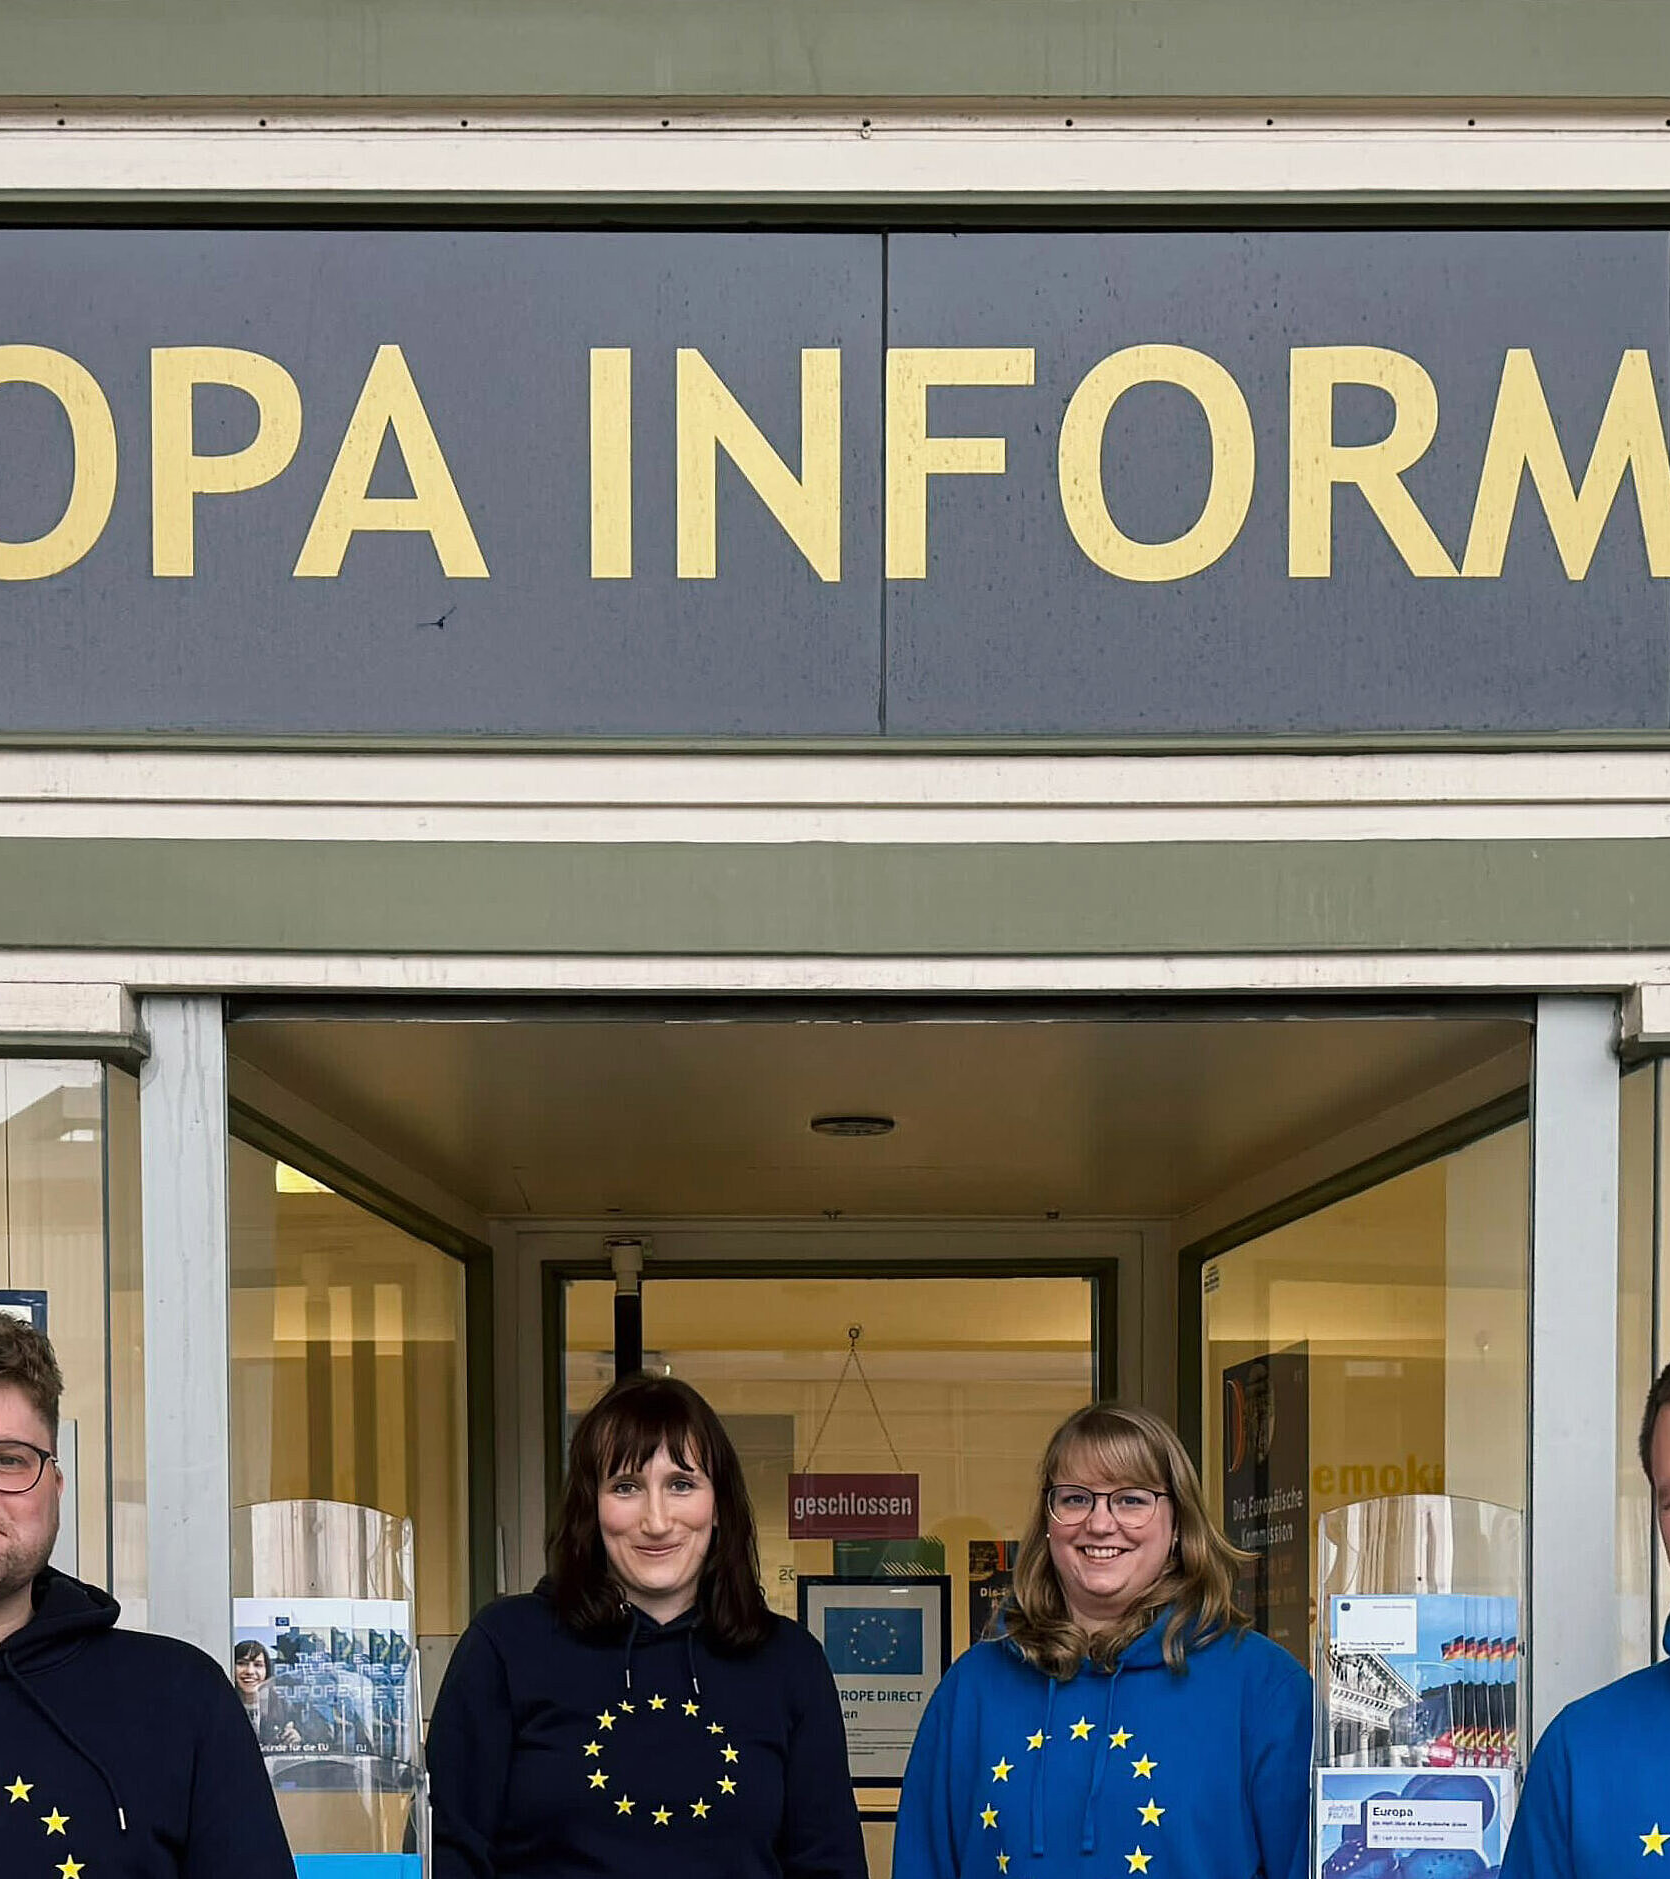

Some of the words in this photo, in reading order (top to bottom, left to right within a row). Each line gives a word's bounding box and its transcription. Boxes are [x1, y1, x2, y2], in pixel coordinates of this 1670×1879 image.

[794, 1491, 912, 1520] geschlossen
[1232, 1498, 1248, 1520] Die
[1248, 1487, 1305, 1519] Europäische
[1240, 1521, 1294, 1549] Kommission
[840, 1690, 874, 1702] ROPE
[877, 1690, 923, 1702] DIRECT
[1372, 1807, 1414, 1818] Europa
